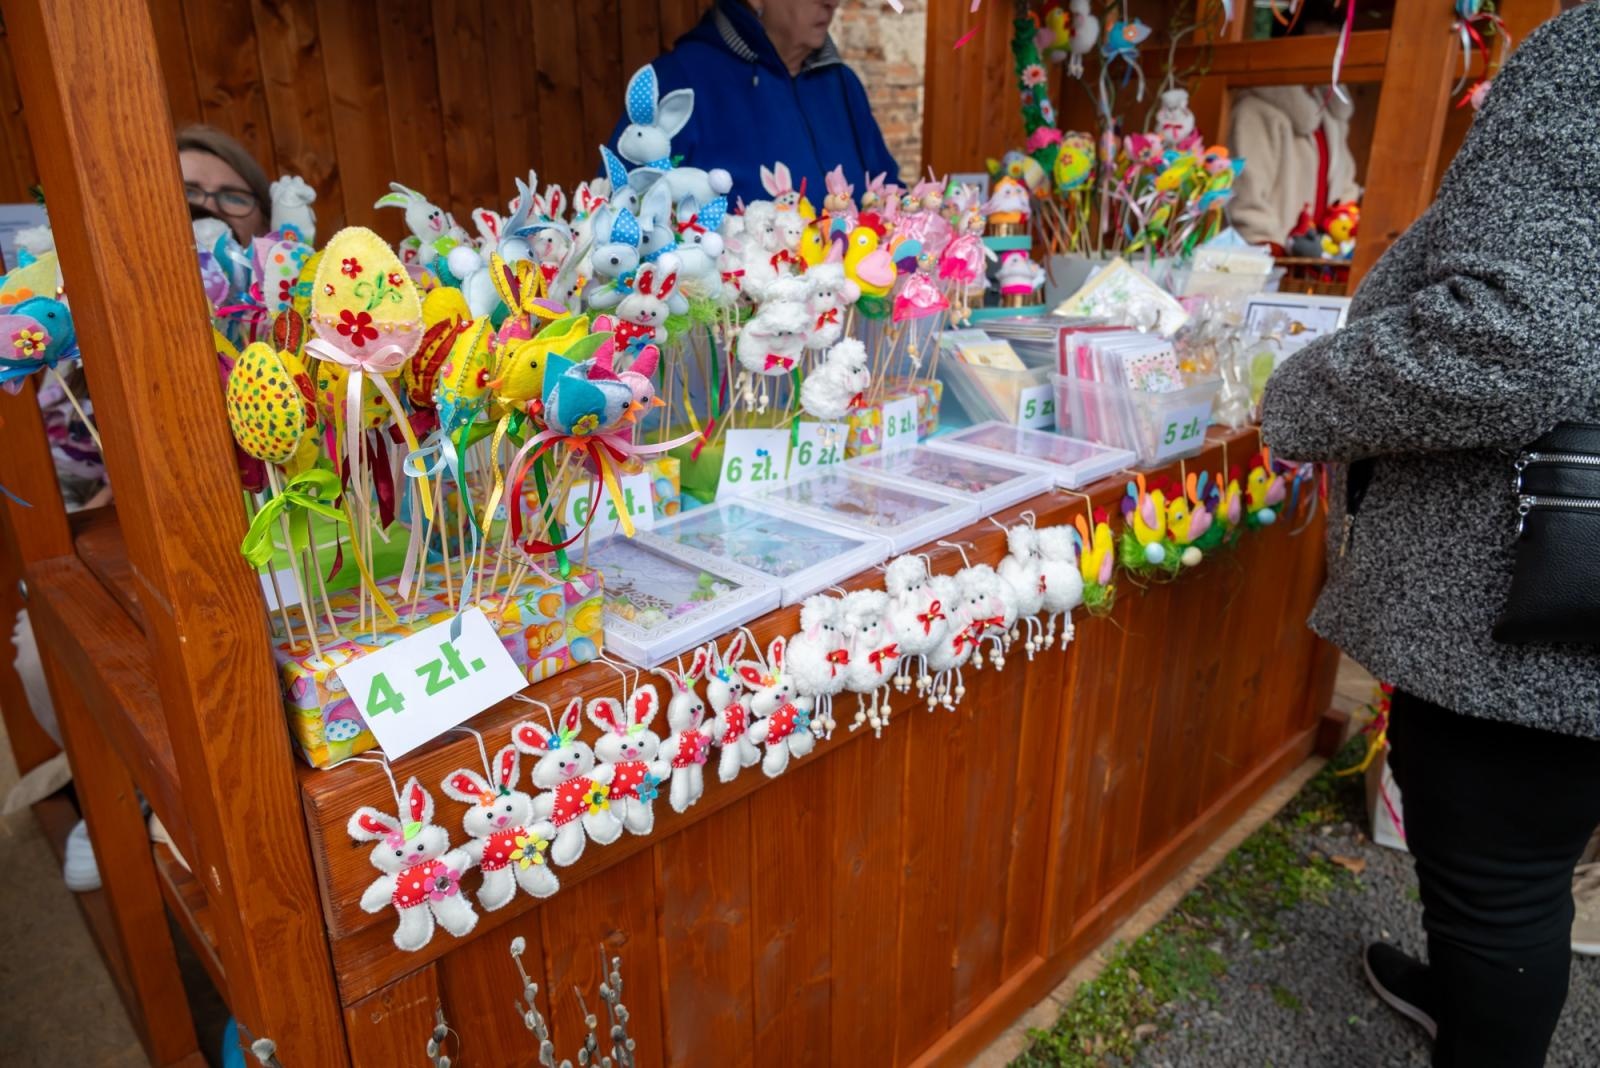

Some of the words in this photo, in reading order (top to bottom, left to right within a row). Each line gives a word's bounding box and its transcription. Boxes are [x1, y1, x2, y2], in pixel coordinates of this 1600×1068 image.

[1024, 399, 1037, 420] 5
[886, 415, 896, 437] 8
[1164, 422, 1178, 445] 5
[798, 441, 813, 465] 6
[726, 457, 742, 482] 6
[751, 455, 778, 481] zł.
[573, 497, 595, 527] 6
[366, 672, 405, 717] 4
[415, 641, 486, 697] zł.
